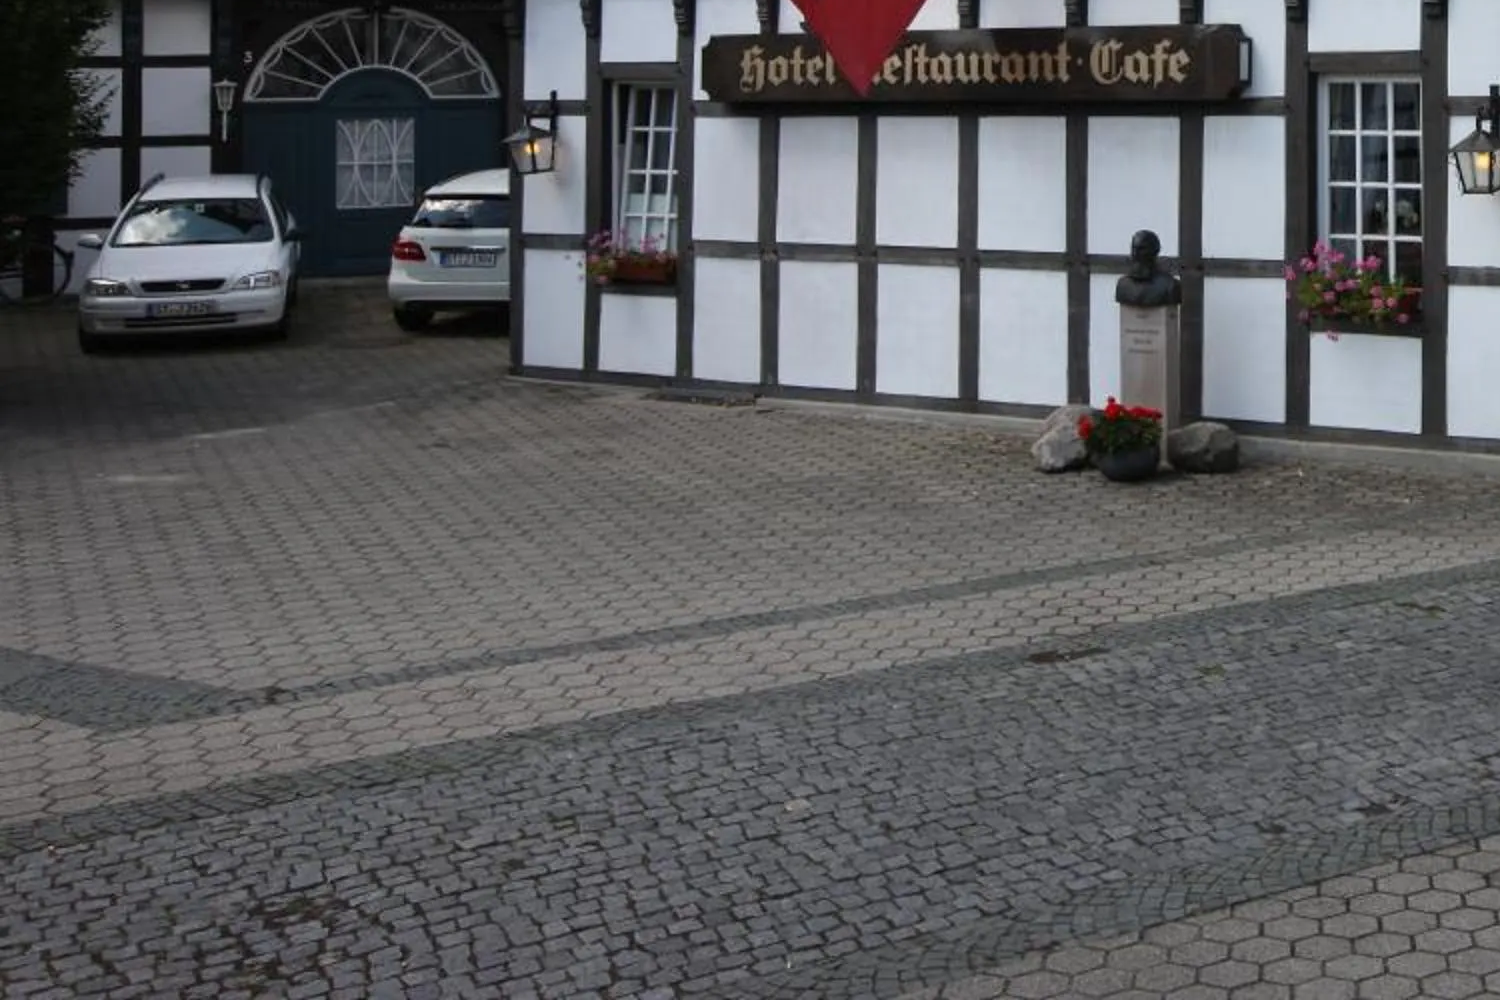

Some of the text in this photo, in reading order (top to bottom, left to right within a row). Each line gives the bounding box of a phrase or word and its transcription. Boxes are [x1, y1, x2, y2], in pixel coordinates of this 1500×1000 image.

[739, 38, 1191, 92] Hotel estaurant Cafe
